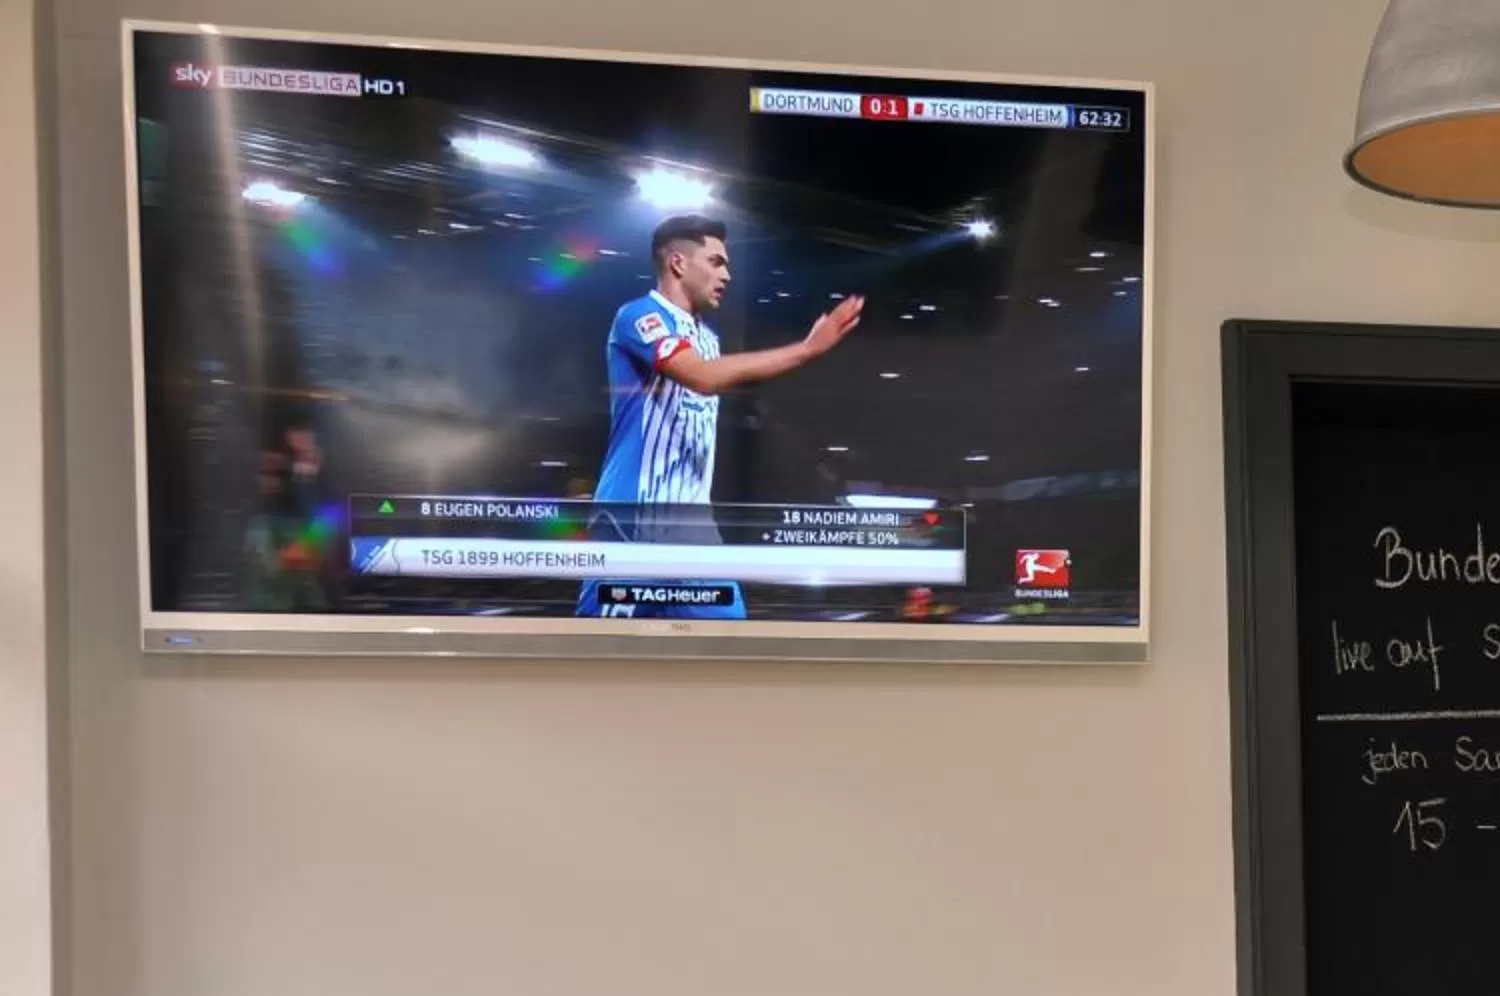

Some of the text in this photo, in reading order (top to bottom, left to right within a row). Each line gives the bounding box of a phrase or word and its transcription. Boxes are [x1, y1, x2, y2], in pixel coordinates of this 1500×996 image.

[175, 63, 212, 86] sky
[223, 69, 358, 91] BUNDESLIGA
[763, 92, 854, 113] DORTMUND
[930, 102, 1063, 123] TSG HOFFENHEIM
[420, 501, 560, 519] 8 EUGEN POLANSKI
[783, 510, 900, 527] 18 NADIEM AMIRI
[773, 529, 900, 546] ZWEIKÄMPFE 50%
[421, 549, 607, 569] TSG 1899 HOFFENHEIM
[1331, 620, 1375, 676] live
[1387, 615, 1444, 692] auf
[1361, 737, 1429, 785] jeden
[1393, 797, 1448, 852] 15
